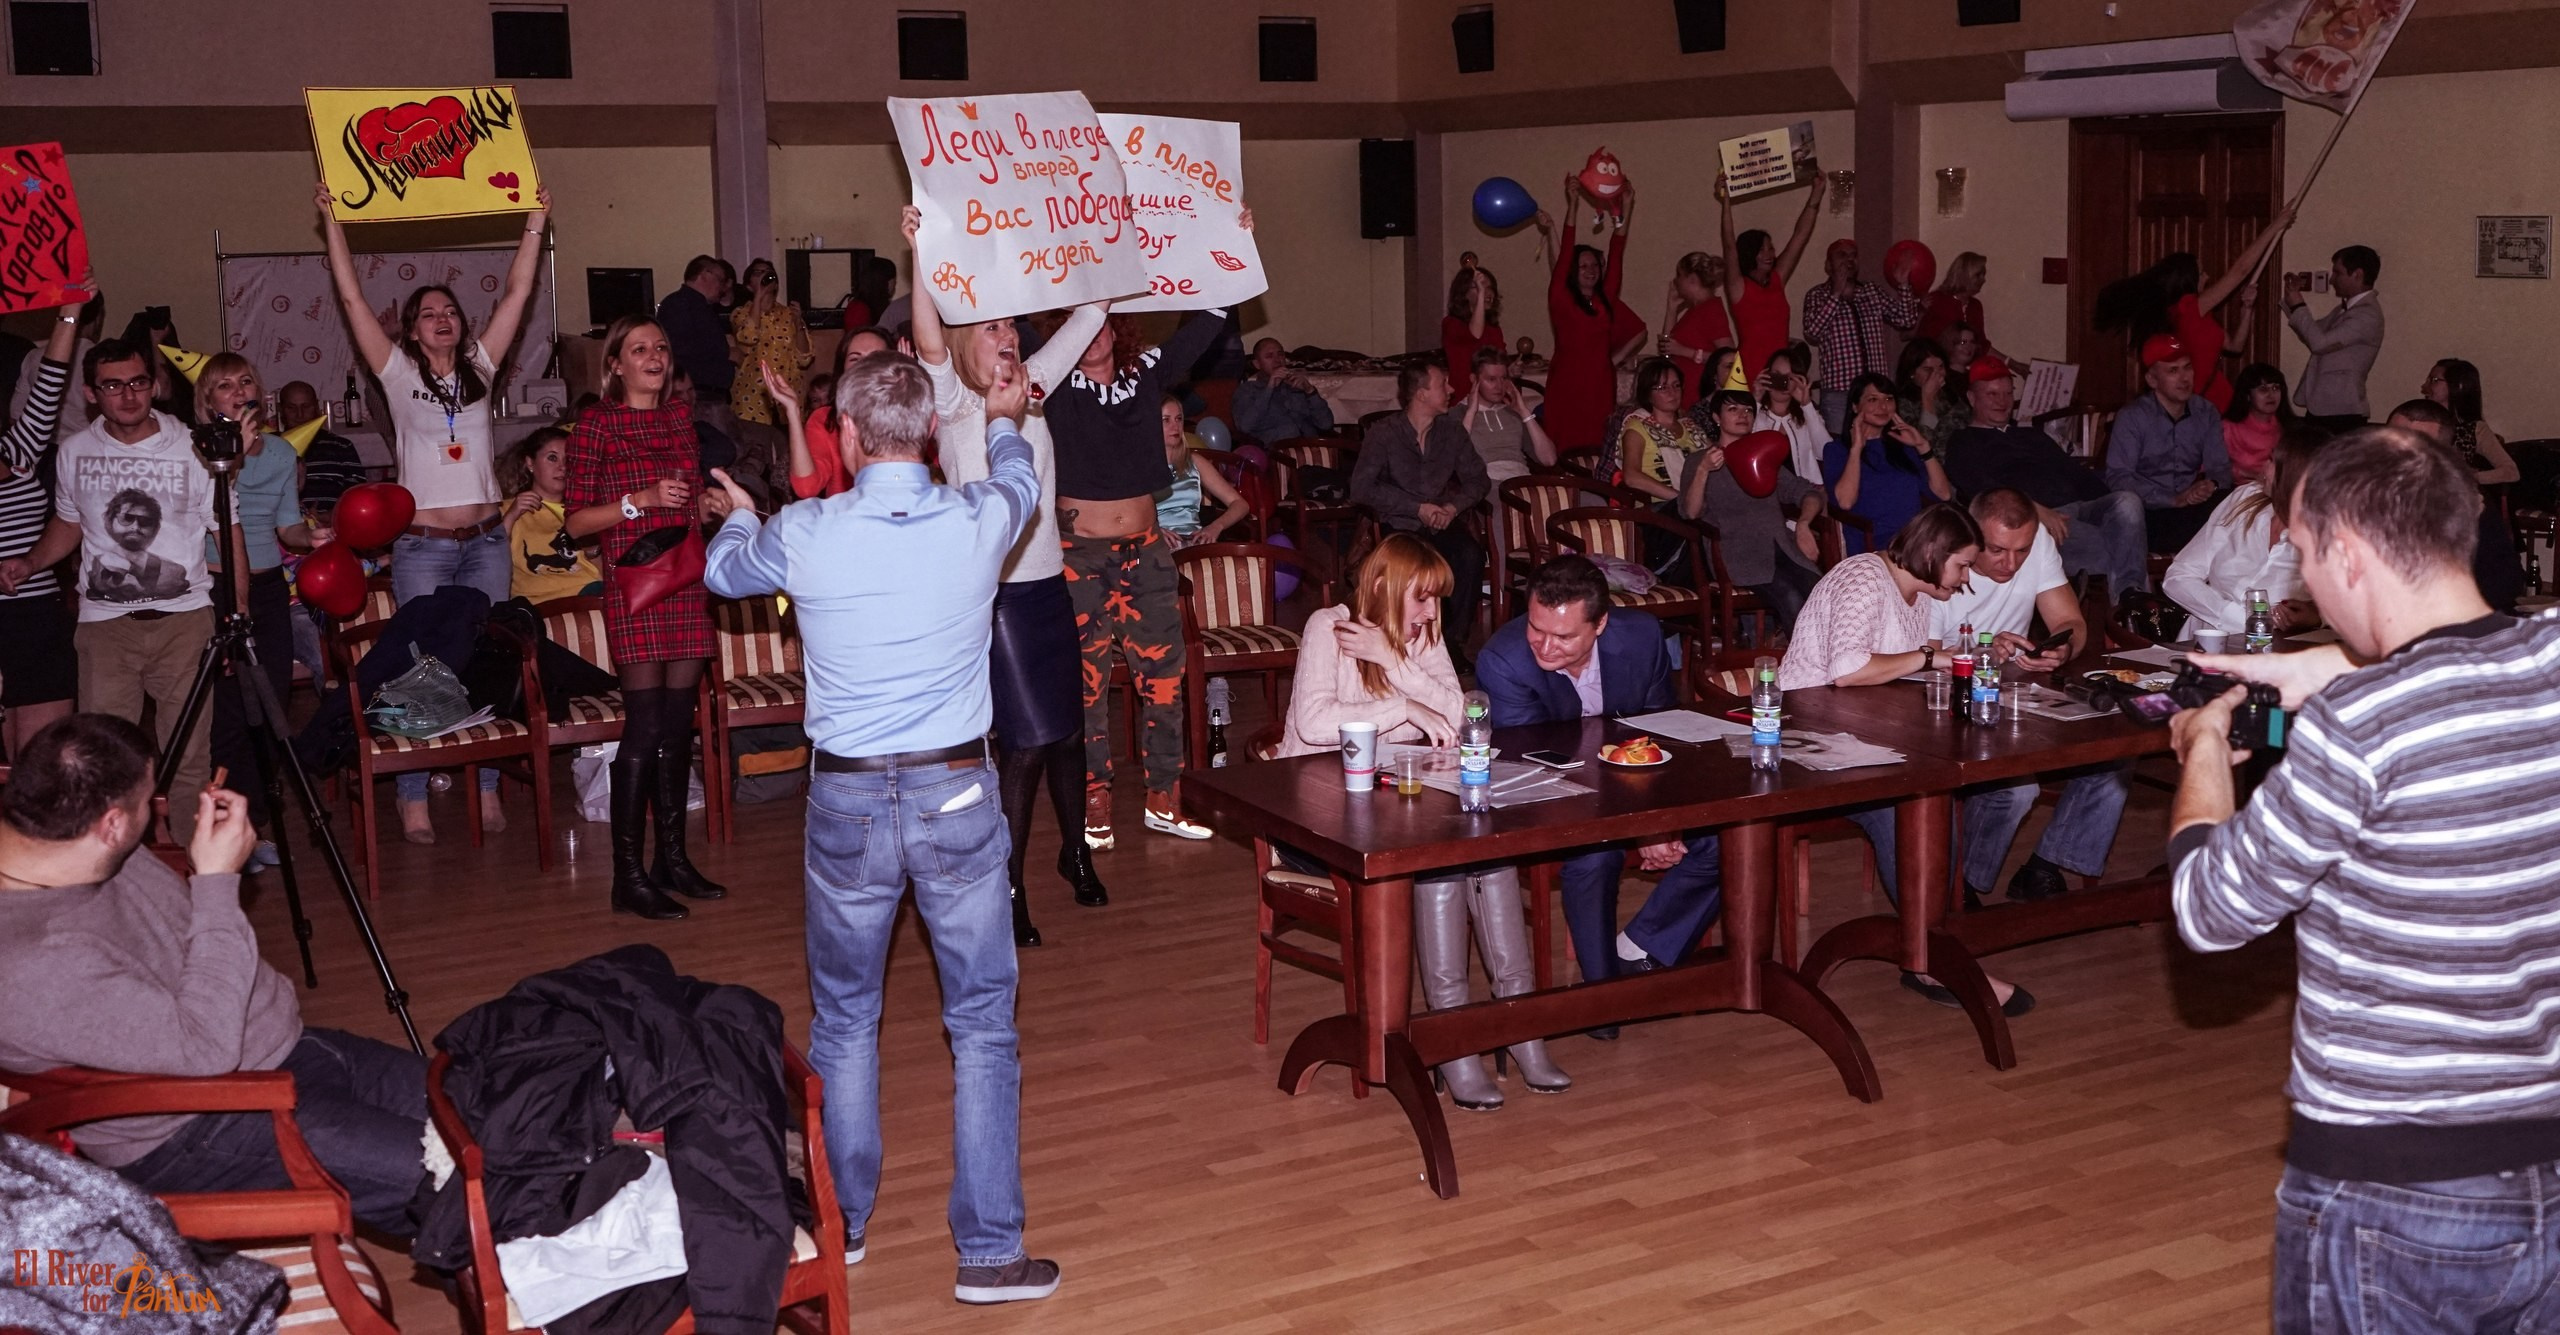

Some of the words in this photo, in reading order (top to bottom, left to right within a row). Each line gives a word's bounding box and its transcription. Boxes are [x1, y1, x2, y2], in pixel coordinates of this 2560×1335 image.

[921, 103, 1013, 184] Леди
[1015, 112, 1037, 150] в
[1042, 124, 1112, 161] пледе
[1013, 155, 1079, 188] вперед
[1124, 125, 1145, 156] в
[1155, 142, 1233, 204] пледе
[966, 198, 1032, 236] Вас
[79, 458, 185, 478] HANGOVER
[79, 474, 111, 492] THE
[115, 476, 185, 494] MOVIE
